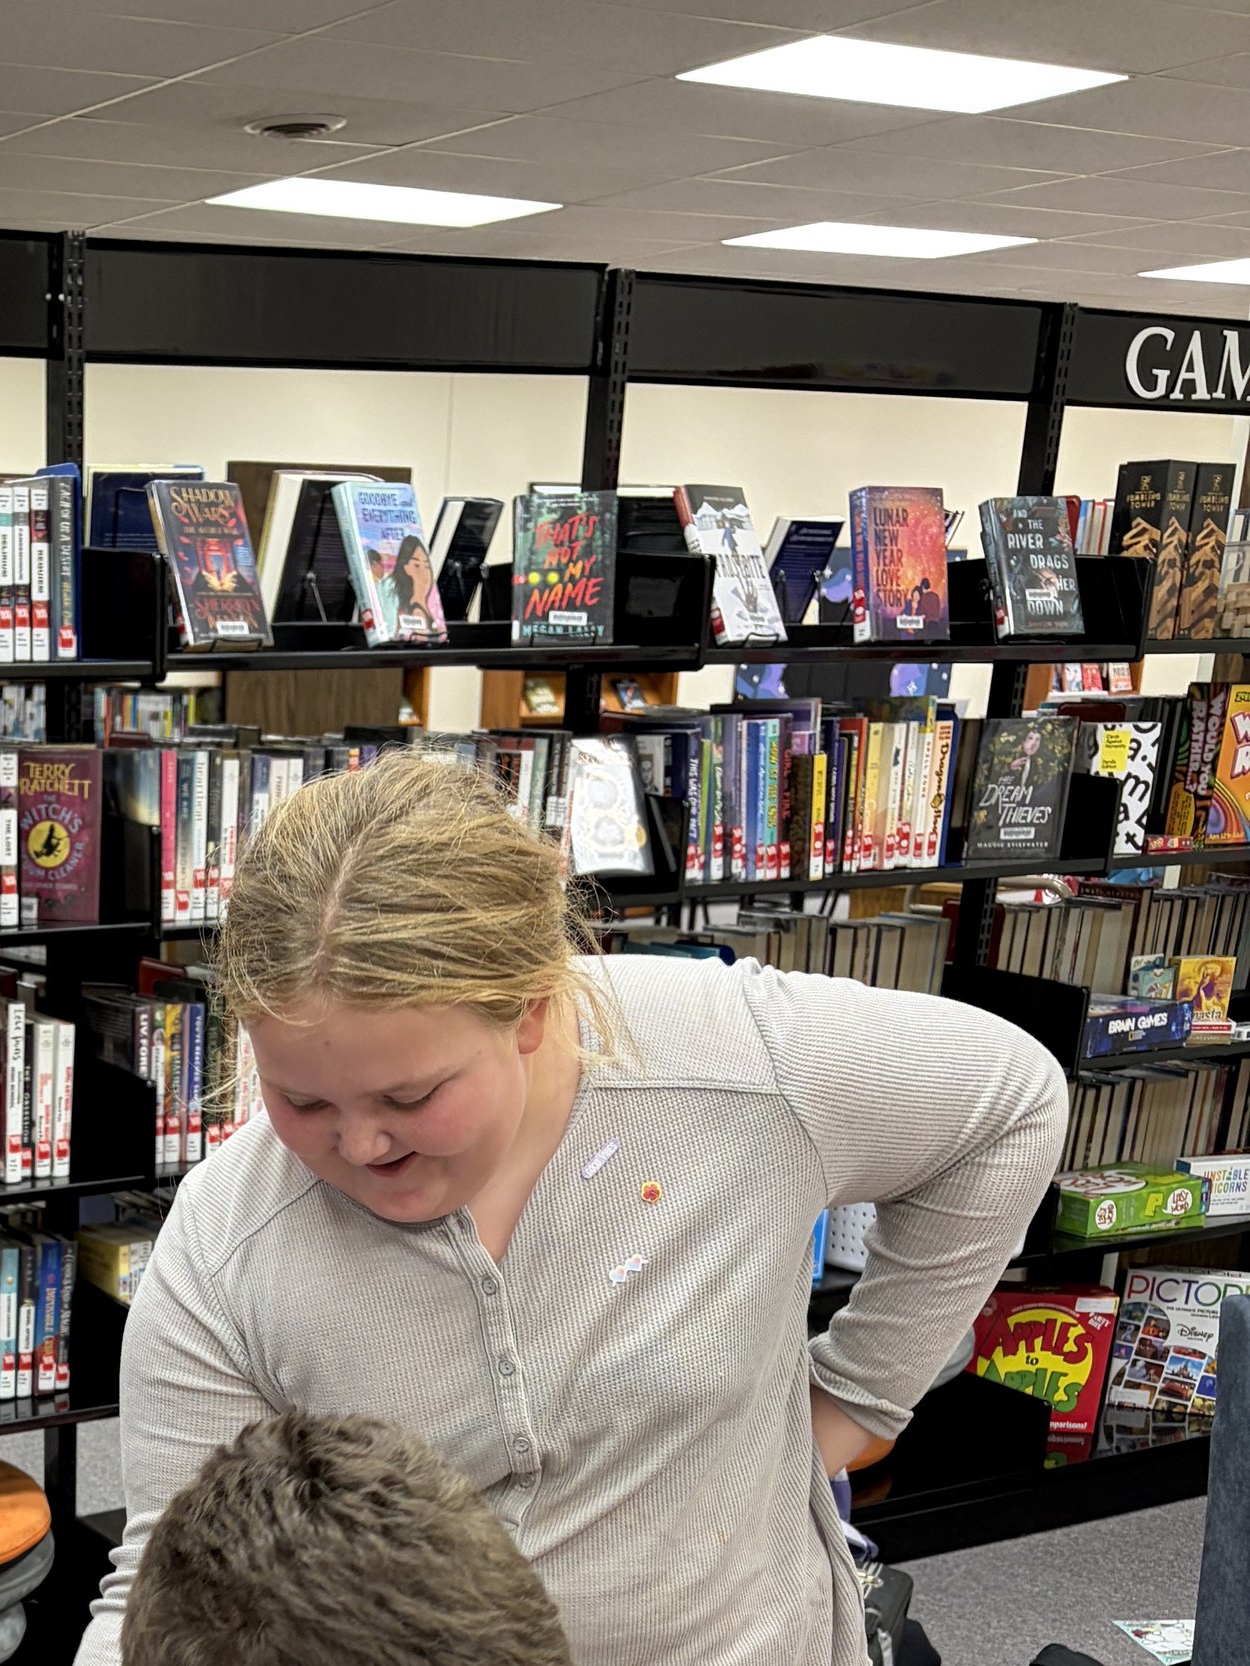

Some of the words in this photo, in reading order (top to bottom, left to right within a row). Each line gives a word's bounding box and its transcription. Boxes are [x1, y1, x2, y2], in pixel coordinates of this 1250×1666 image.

[874, 508, 908, 527] LUNAR
[1028, 520, 1043, 529] THE
[535, 513, 598, 547] THAT'S
[874, 529, 899, 546] NEW
[1008, 534, 1043, 549] RIVER
[543, 541, 585, 569] NOT
[875, 550, 903, 567] YEAR
[1030, 555, 1069, 569] DRAGS
[564, 554, 596, 580] MY
[1057, 578, 1075, 591] HER
[525, 577, 604, 620] NAME
[1027, 601, 1063, 615] DOWN
[1203, 692, 1224, 761] WOULD
[23, 762, 76, 780] TERRY
[1197, 767, 1211, 795] YOU
[19, 778, 92, 800] RATCHETT
[979, 784, 1033, 812] DREAM
[999, 804, 1051, 826] THIEVES
[1108, 1017, 1136, 1035] BRAIN
[1137, 1012, 1168, 1030] GAMES
[1211, 1181, 1248, 1192] ICORNS
[980, 1308, 1094, 1365] APPLES
[1025, 1354, 1039, 1365] to
